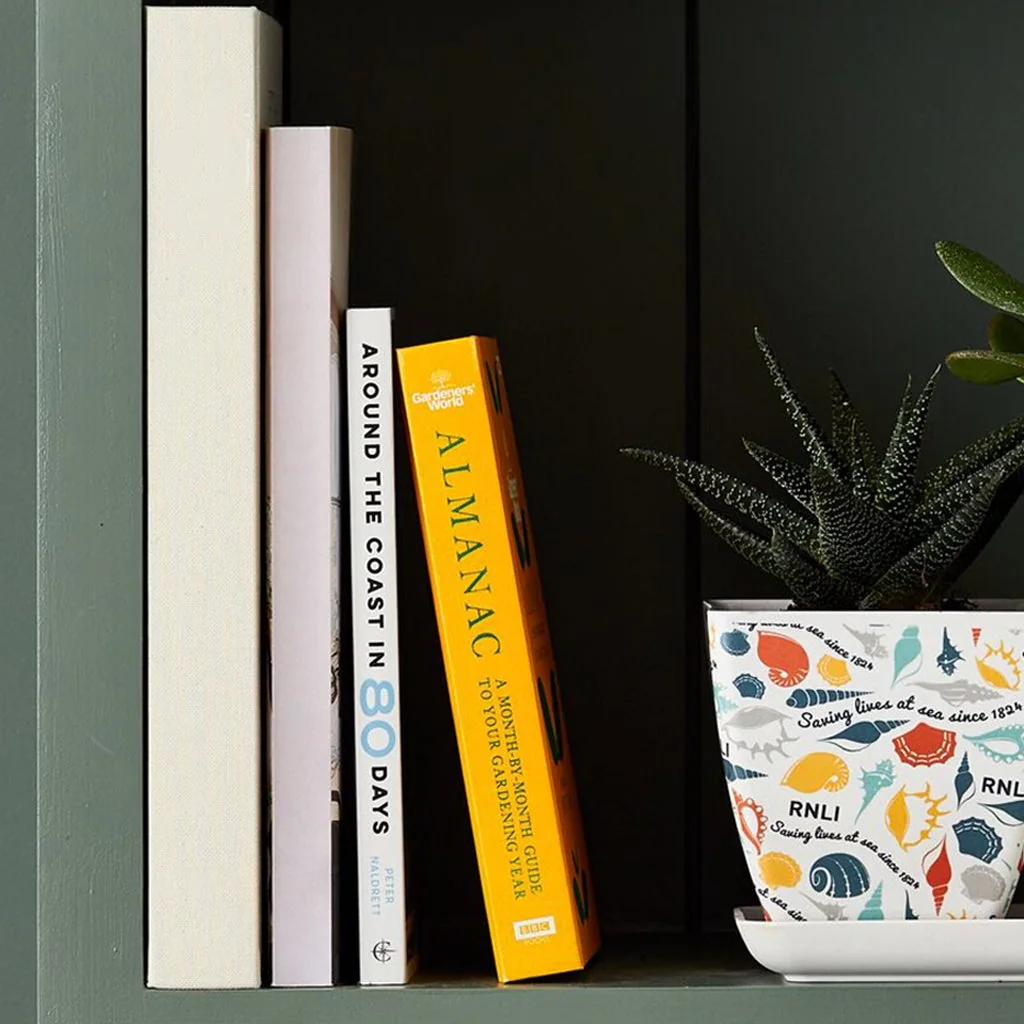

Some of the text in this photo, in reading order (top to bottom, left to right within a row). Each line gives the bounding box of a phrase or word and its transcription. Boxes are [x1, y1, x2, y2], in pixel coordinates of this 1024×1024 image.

[427, 395, 465, 412] World
[436, 431, 501, 658] ALMANAC
[360, 343, 396, 835] AROUND THE COAST IN 80 DAYS
[805, 625, 825, 640] sea
[823, 639, 849, 659] since
[850, 655, 874, 671] 1824
[797, 695, 1023, 729] Saving lives at sea since 1824
[478, 677, 527, 900] TO YOUR GARDENING YEAR
[495, 679, 543, 896] A MONTH-BY-MONTH GUIDE
[789, 800, 840, 822] RNLI
[769, 820, 920, 890] Saving lives at sea since 1824
[369, 856, 380, 916] NALDRETT
[385, 867, 394, 904] PETER
[770, 896, 788, 911] sea
